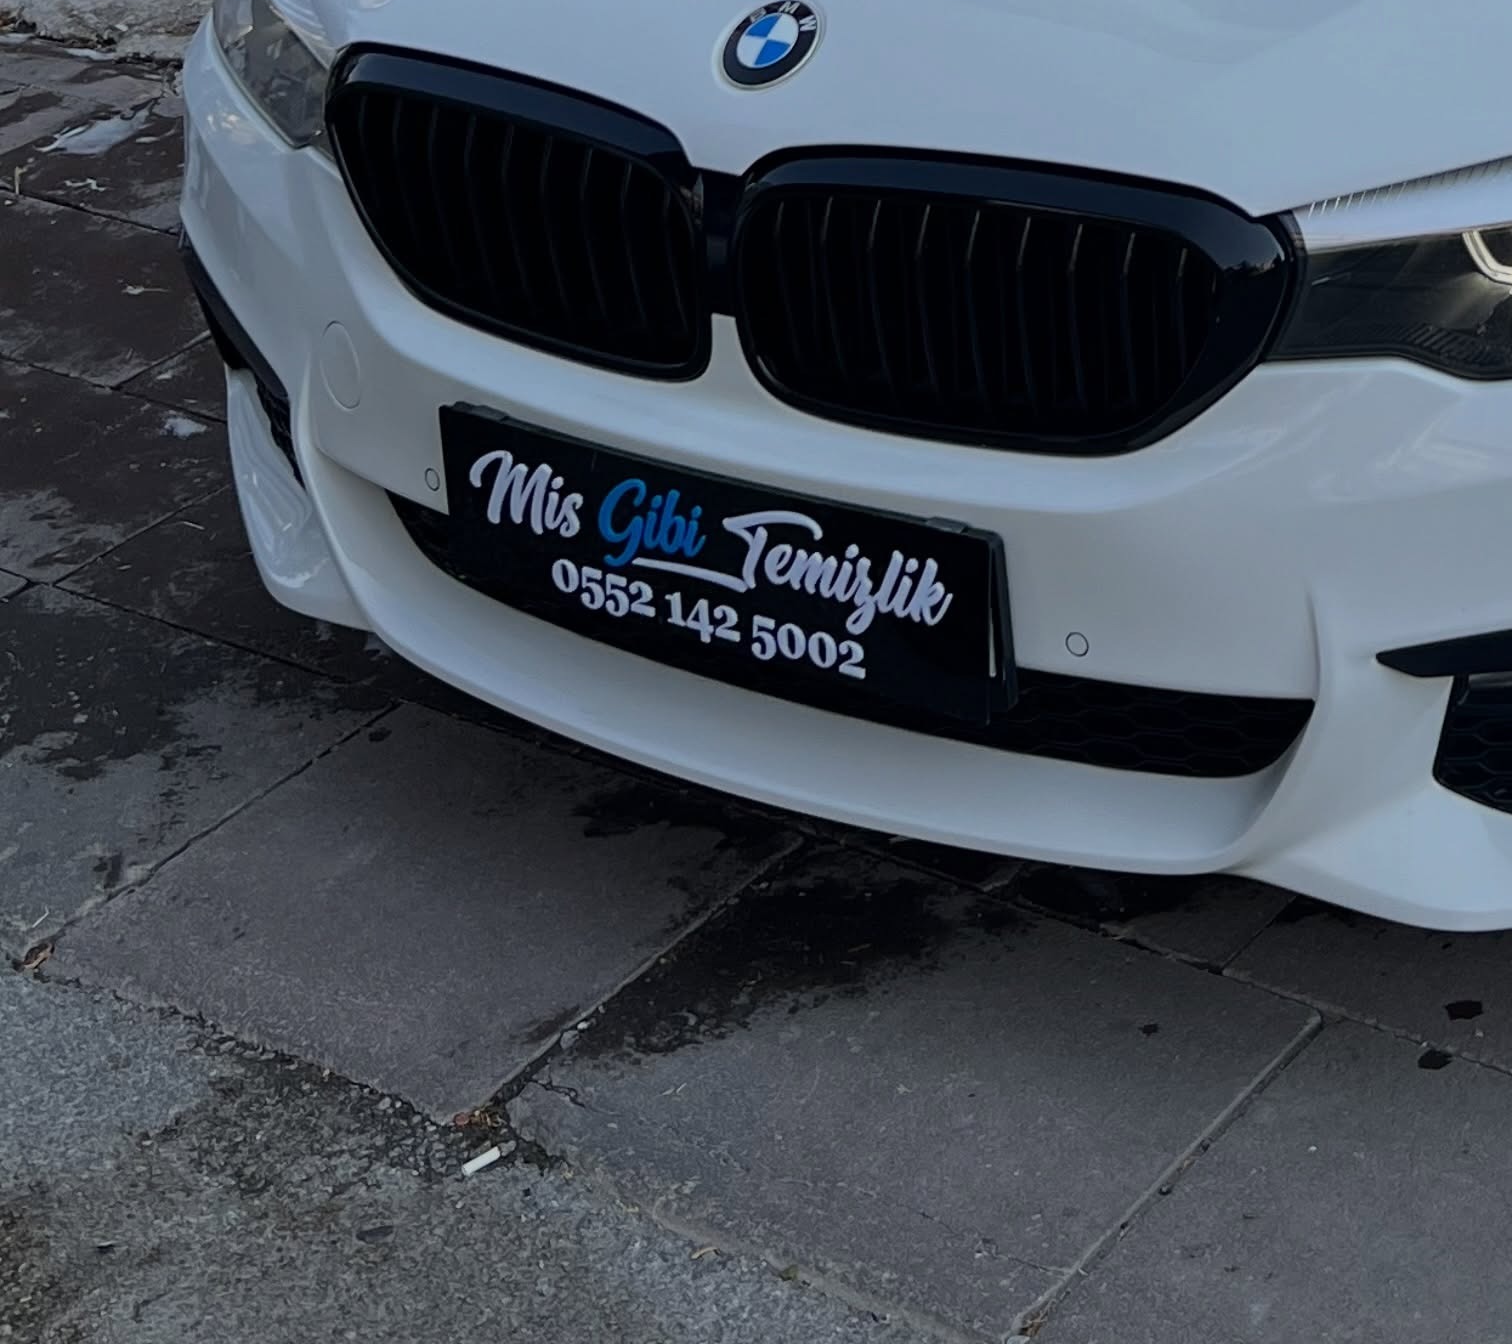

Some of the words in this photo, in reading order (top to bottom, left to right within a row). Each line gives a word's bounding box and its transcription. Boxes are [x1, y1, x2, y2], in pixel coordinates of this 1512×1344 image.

[469, 450, 584, 538] Mis
[599, 478, 707, 568] Gibi
[722, 510, 954, 635] Temizlik
[551, 558, 656, 618] 0552
[665, 591, 741, 643] 142
[751, 614, 866, 679] 5002
